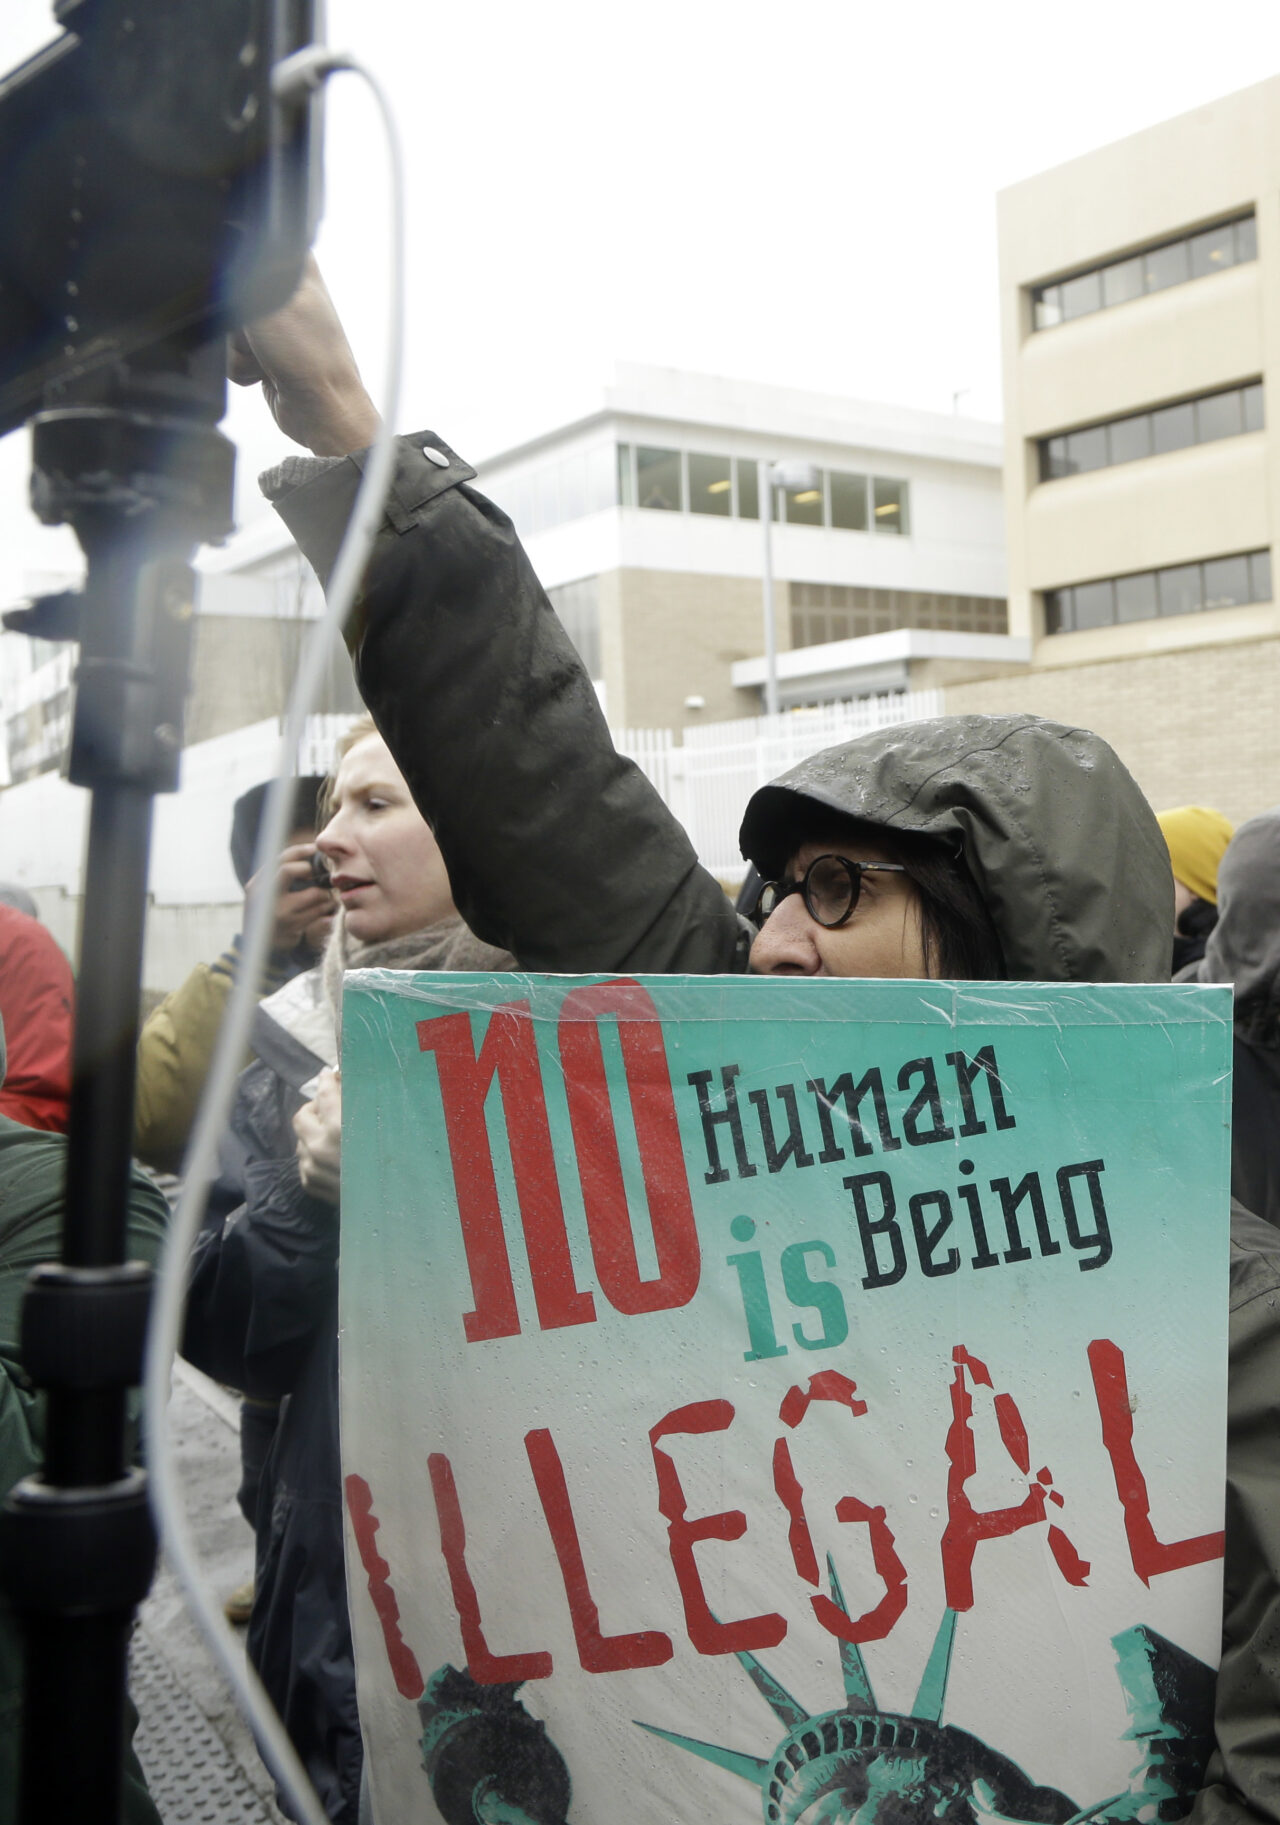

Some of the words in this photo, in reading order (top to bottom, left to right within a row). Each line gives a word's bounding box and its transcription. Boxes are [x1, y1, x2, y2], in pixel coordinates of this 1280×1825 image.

[686, 1045, 1016, 1186] Human
[725, 1214, 850, 1363] is
[842, 1156, 1114, 1291] Being
[344, 1338, 1226, 1700] ILLEGAL
